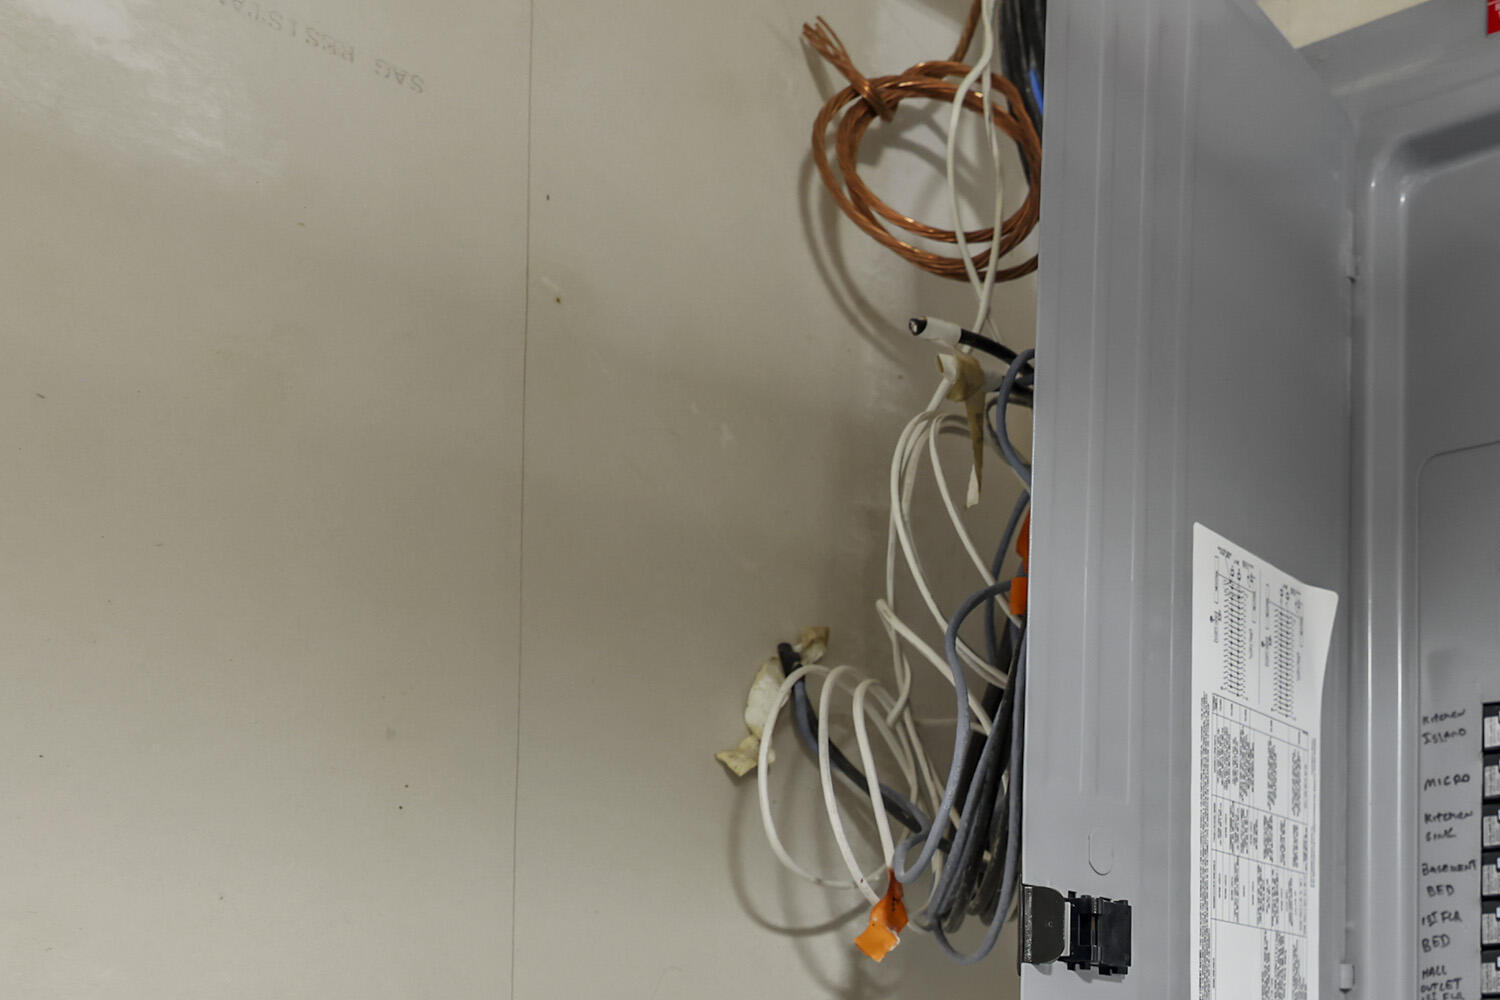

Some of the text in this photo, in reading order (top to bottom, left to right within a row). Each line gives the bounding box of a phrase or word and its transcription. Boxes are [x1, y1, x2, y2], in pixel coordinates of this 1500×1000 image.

[1424, 773, 1470, 791] MICRO
[1426, 884, 1455, 898] BED
[1421, 934, 1451, 953] BED
[1422, 964, 1448, 979] HALL
[1420, 977, 1462, 993] OUTLET
